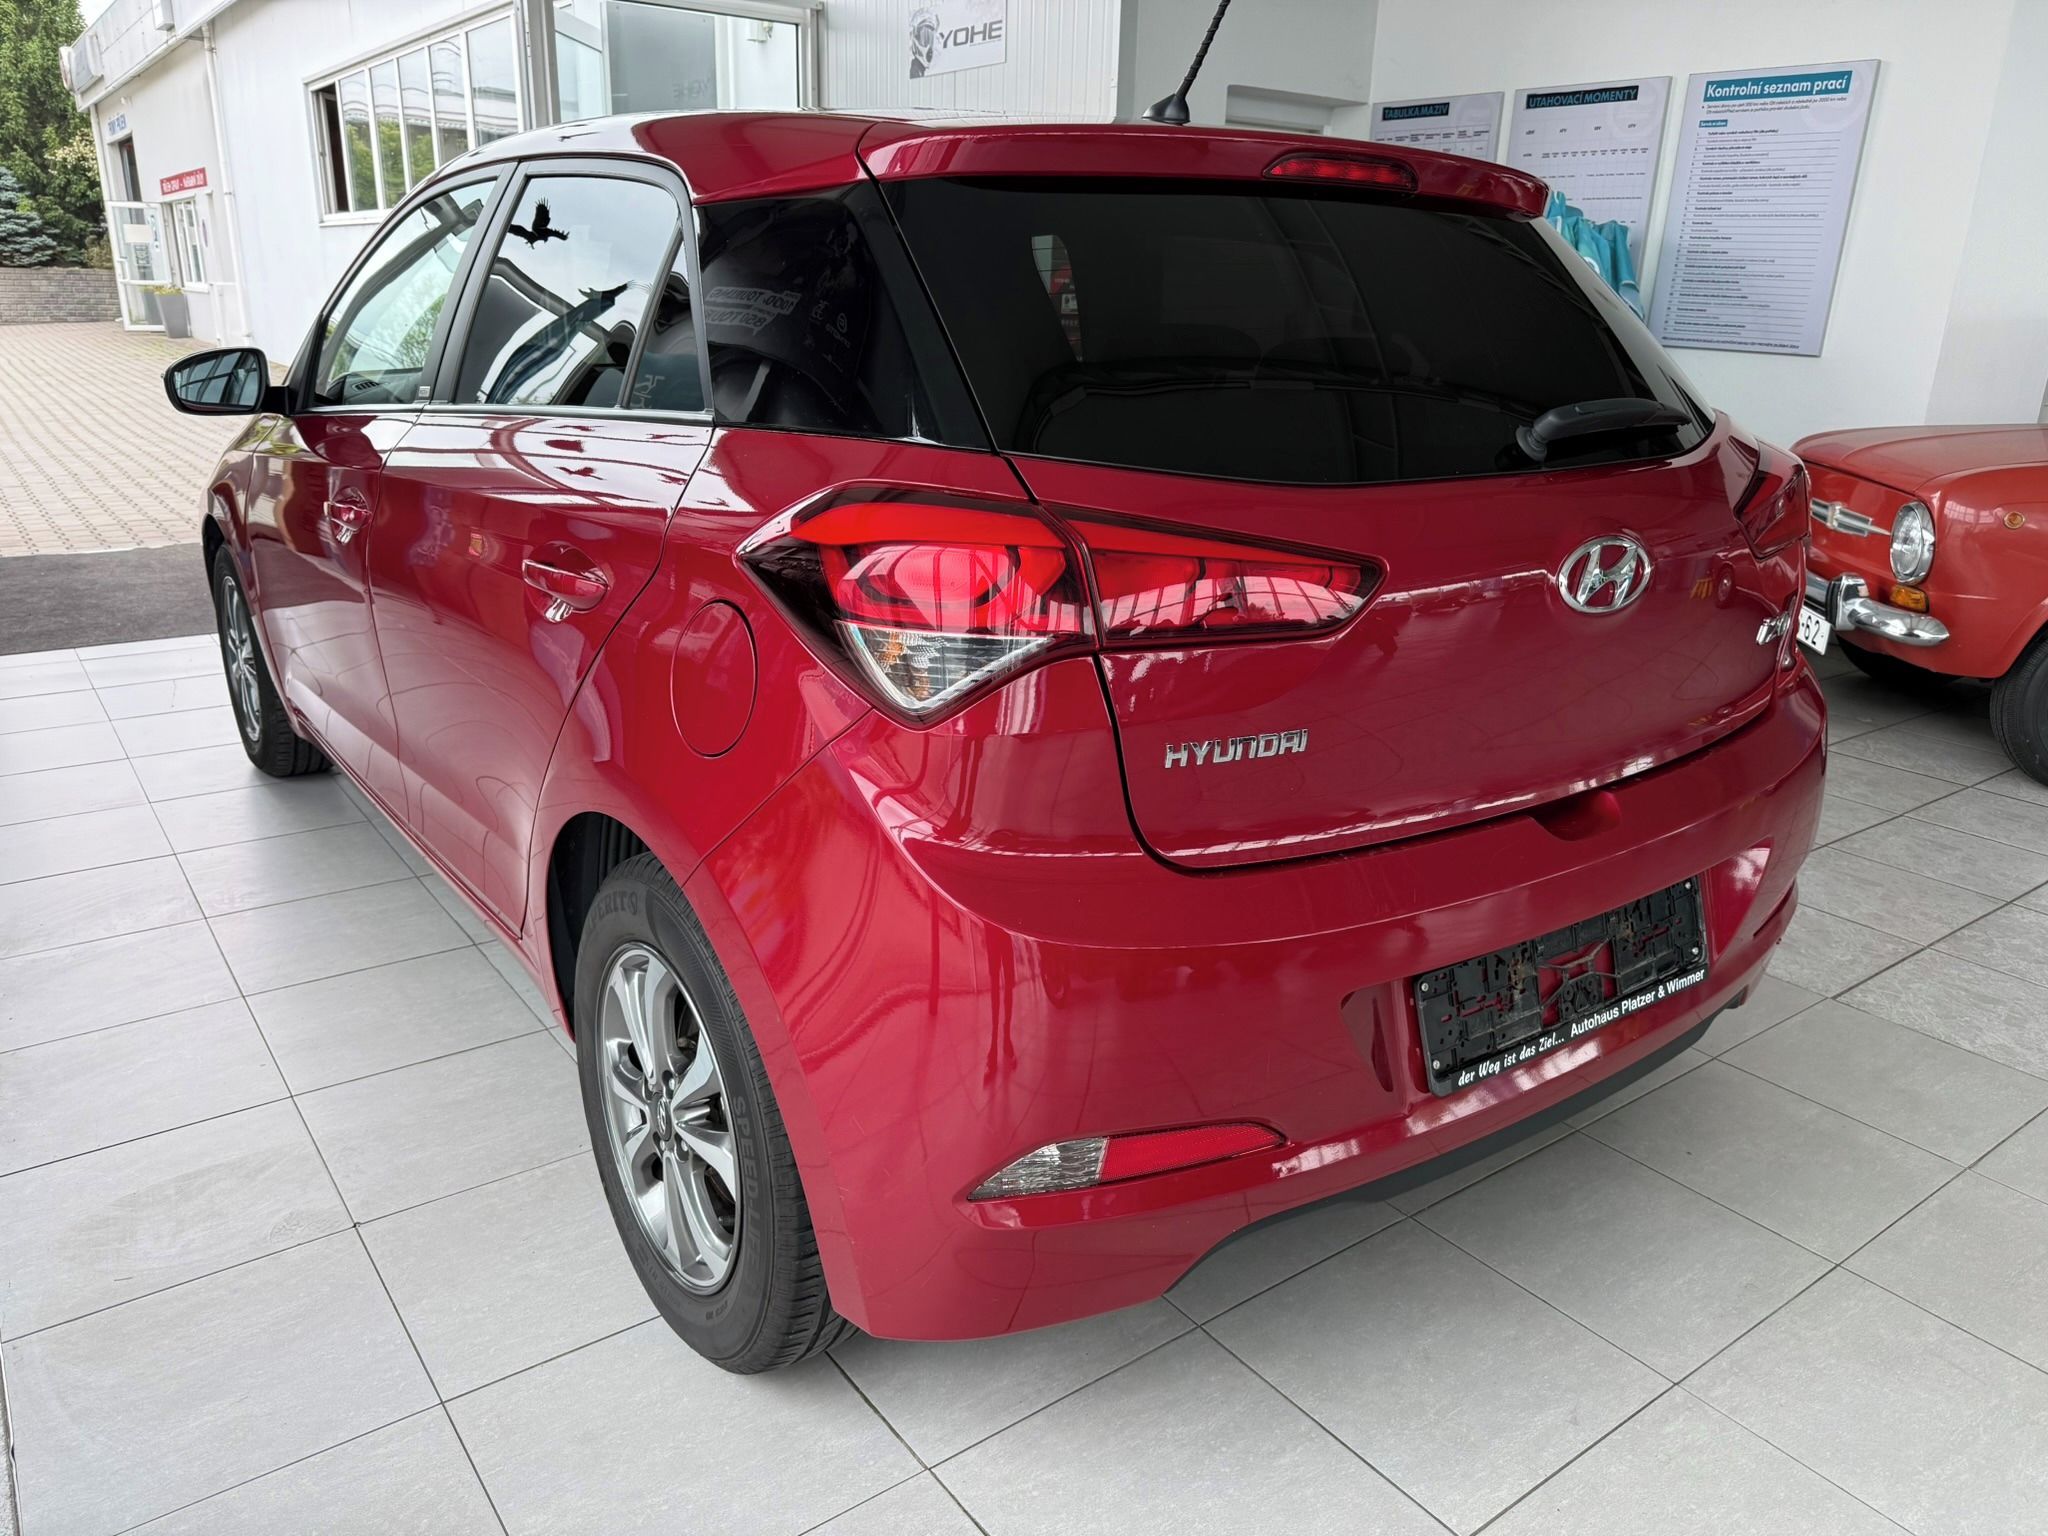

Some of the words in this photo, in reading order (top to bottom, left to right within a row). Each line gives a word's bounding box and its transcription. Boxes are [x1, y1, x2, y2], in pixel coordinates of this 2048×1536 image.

[938, 19, 1003, 49] YOHE
[1529, 91, 1583, 108] UTAHOVACÍ
[1584, 88, 1637, 103] MOMENTY
[1706, 80, 1762, 98] Kontrolní
[1763, 81, 1811, 94] seznam
[1812, 75, 1848, 95] prací
[1384, 105, 1420, 119] TABULKA
[1420, 103, 1449, 117] MAZIV
[1164, 728, 1309, 769] HYUNDAI
[1458, 1070, 1476, 1087] der
[1478, 1059, 1501, 1078] Weg
[1503, 1052, 1517, 1066] ist
[1519, 1042, 1536, 1060] das
[1570, 1007, 1620, 1038] Autohaus
[1621, 991, 1656, 1015] Platzer
[1657, 986, 1665, 998] &
[1666, 968, 1706, 995] Wimmer
